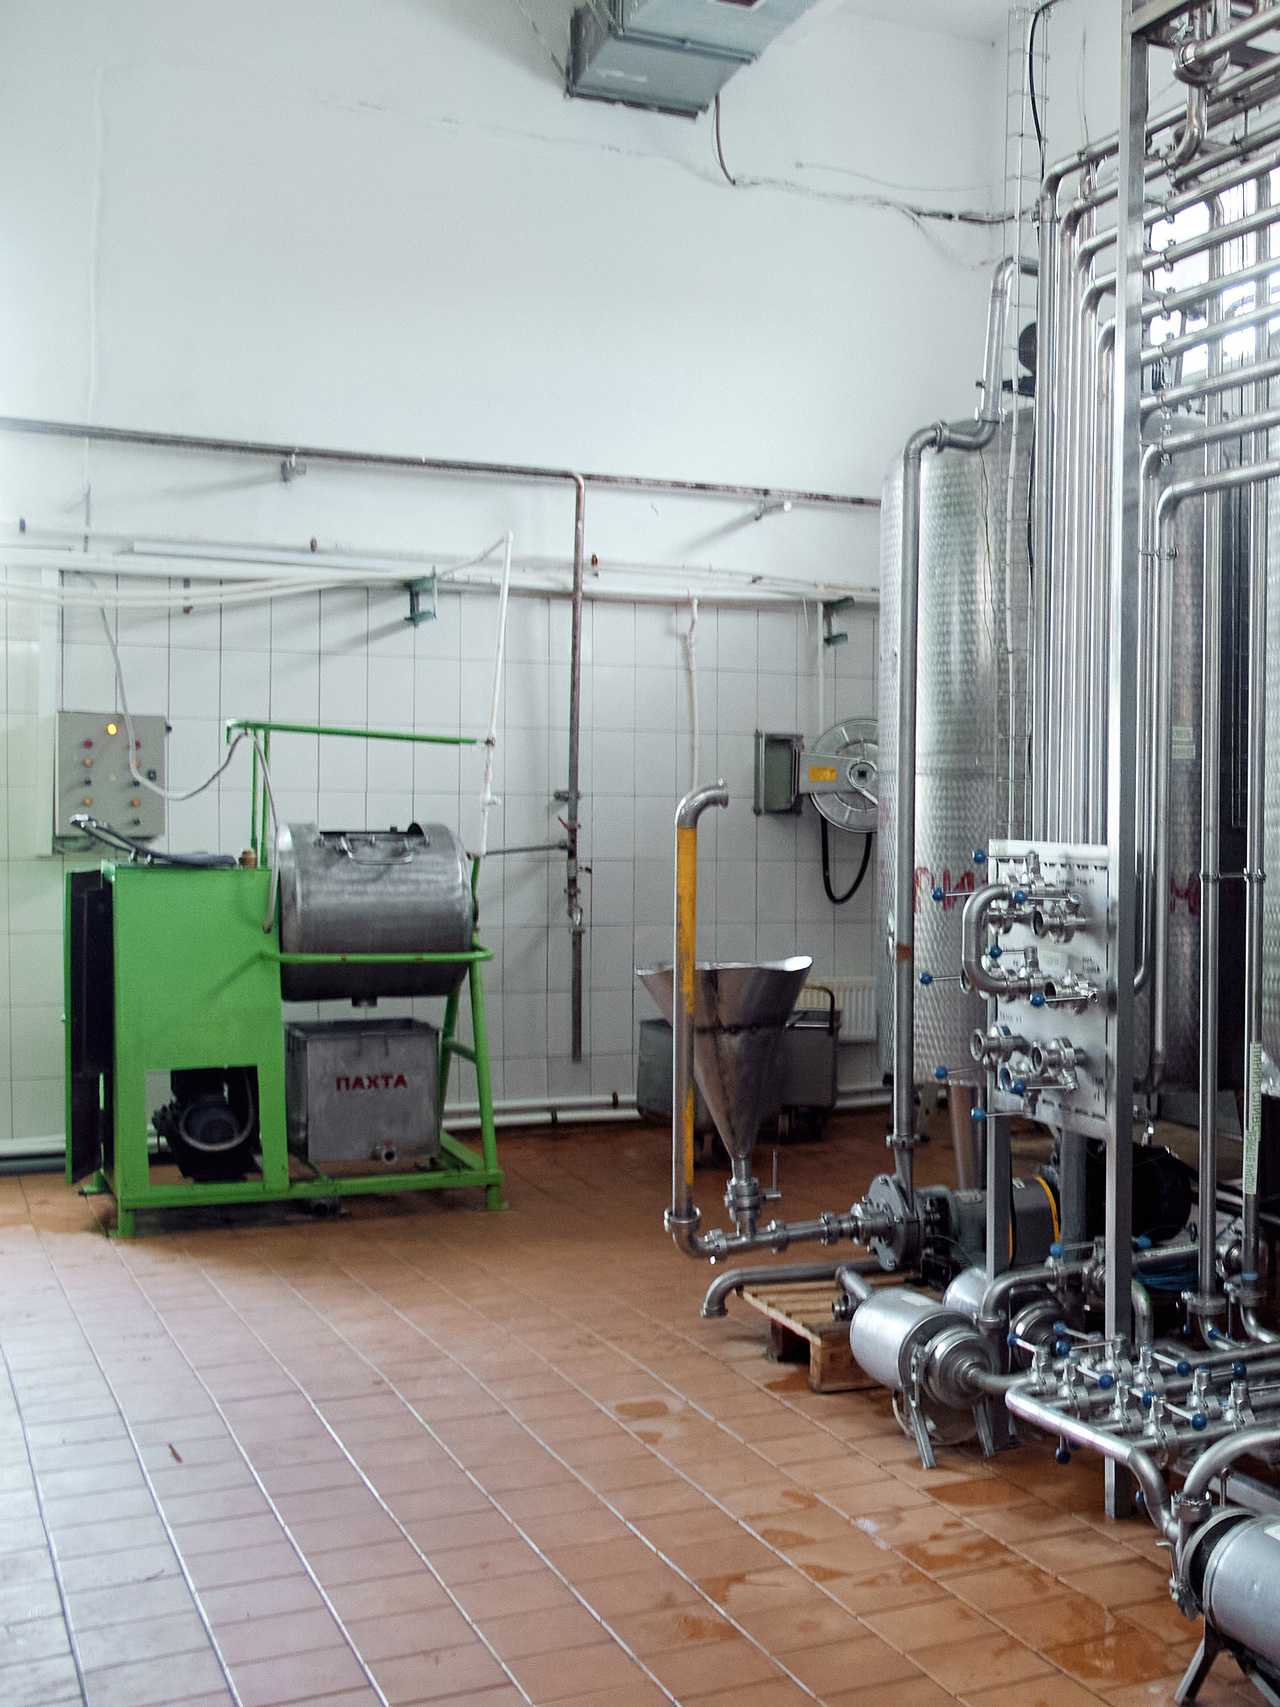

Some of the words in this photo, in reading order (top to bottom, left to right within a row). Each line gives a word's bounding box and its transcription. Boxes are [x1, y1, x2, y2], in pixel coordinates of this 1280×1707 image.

[336, 1073, 408, 1091] ПАХТА
[1252, 1046, 1262, 1087] ЛИНИЯ
[1251, 1091, 1262, 1133] СЛИВО
